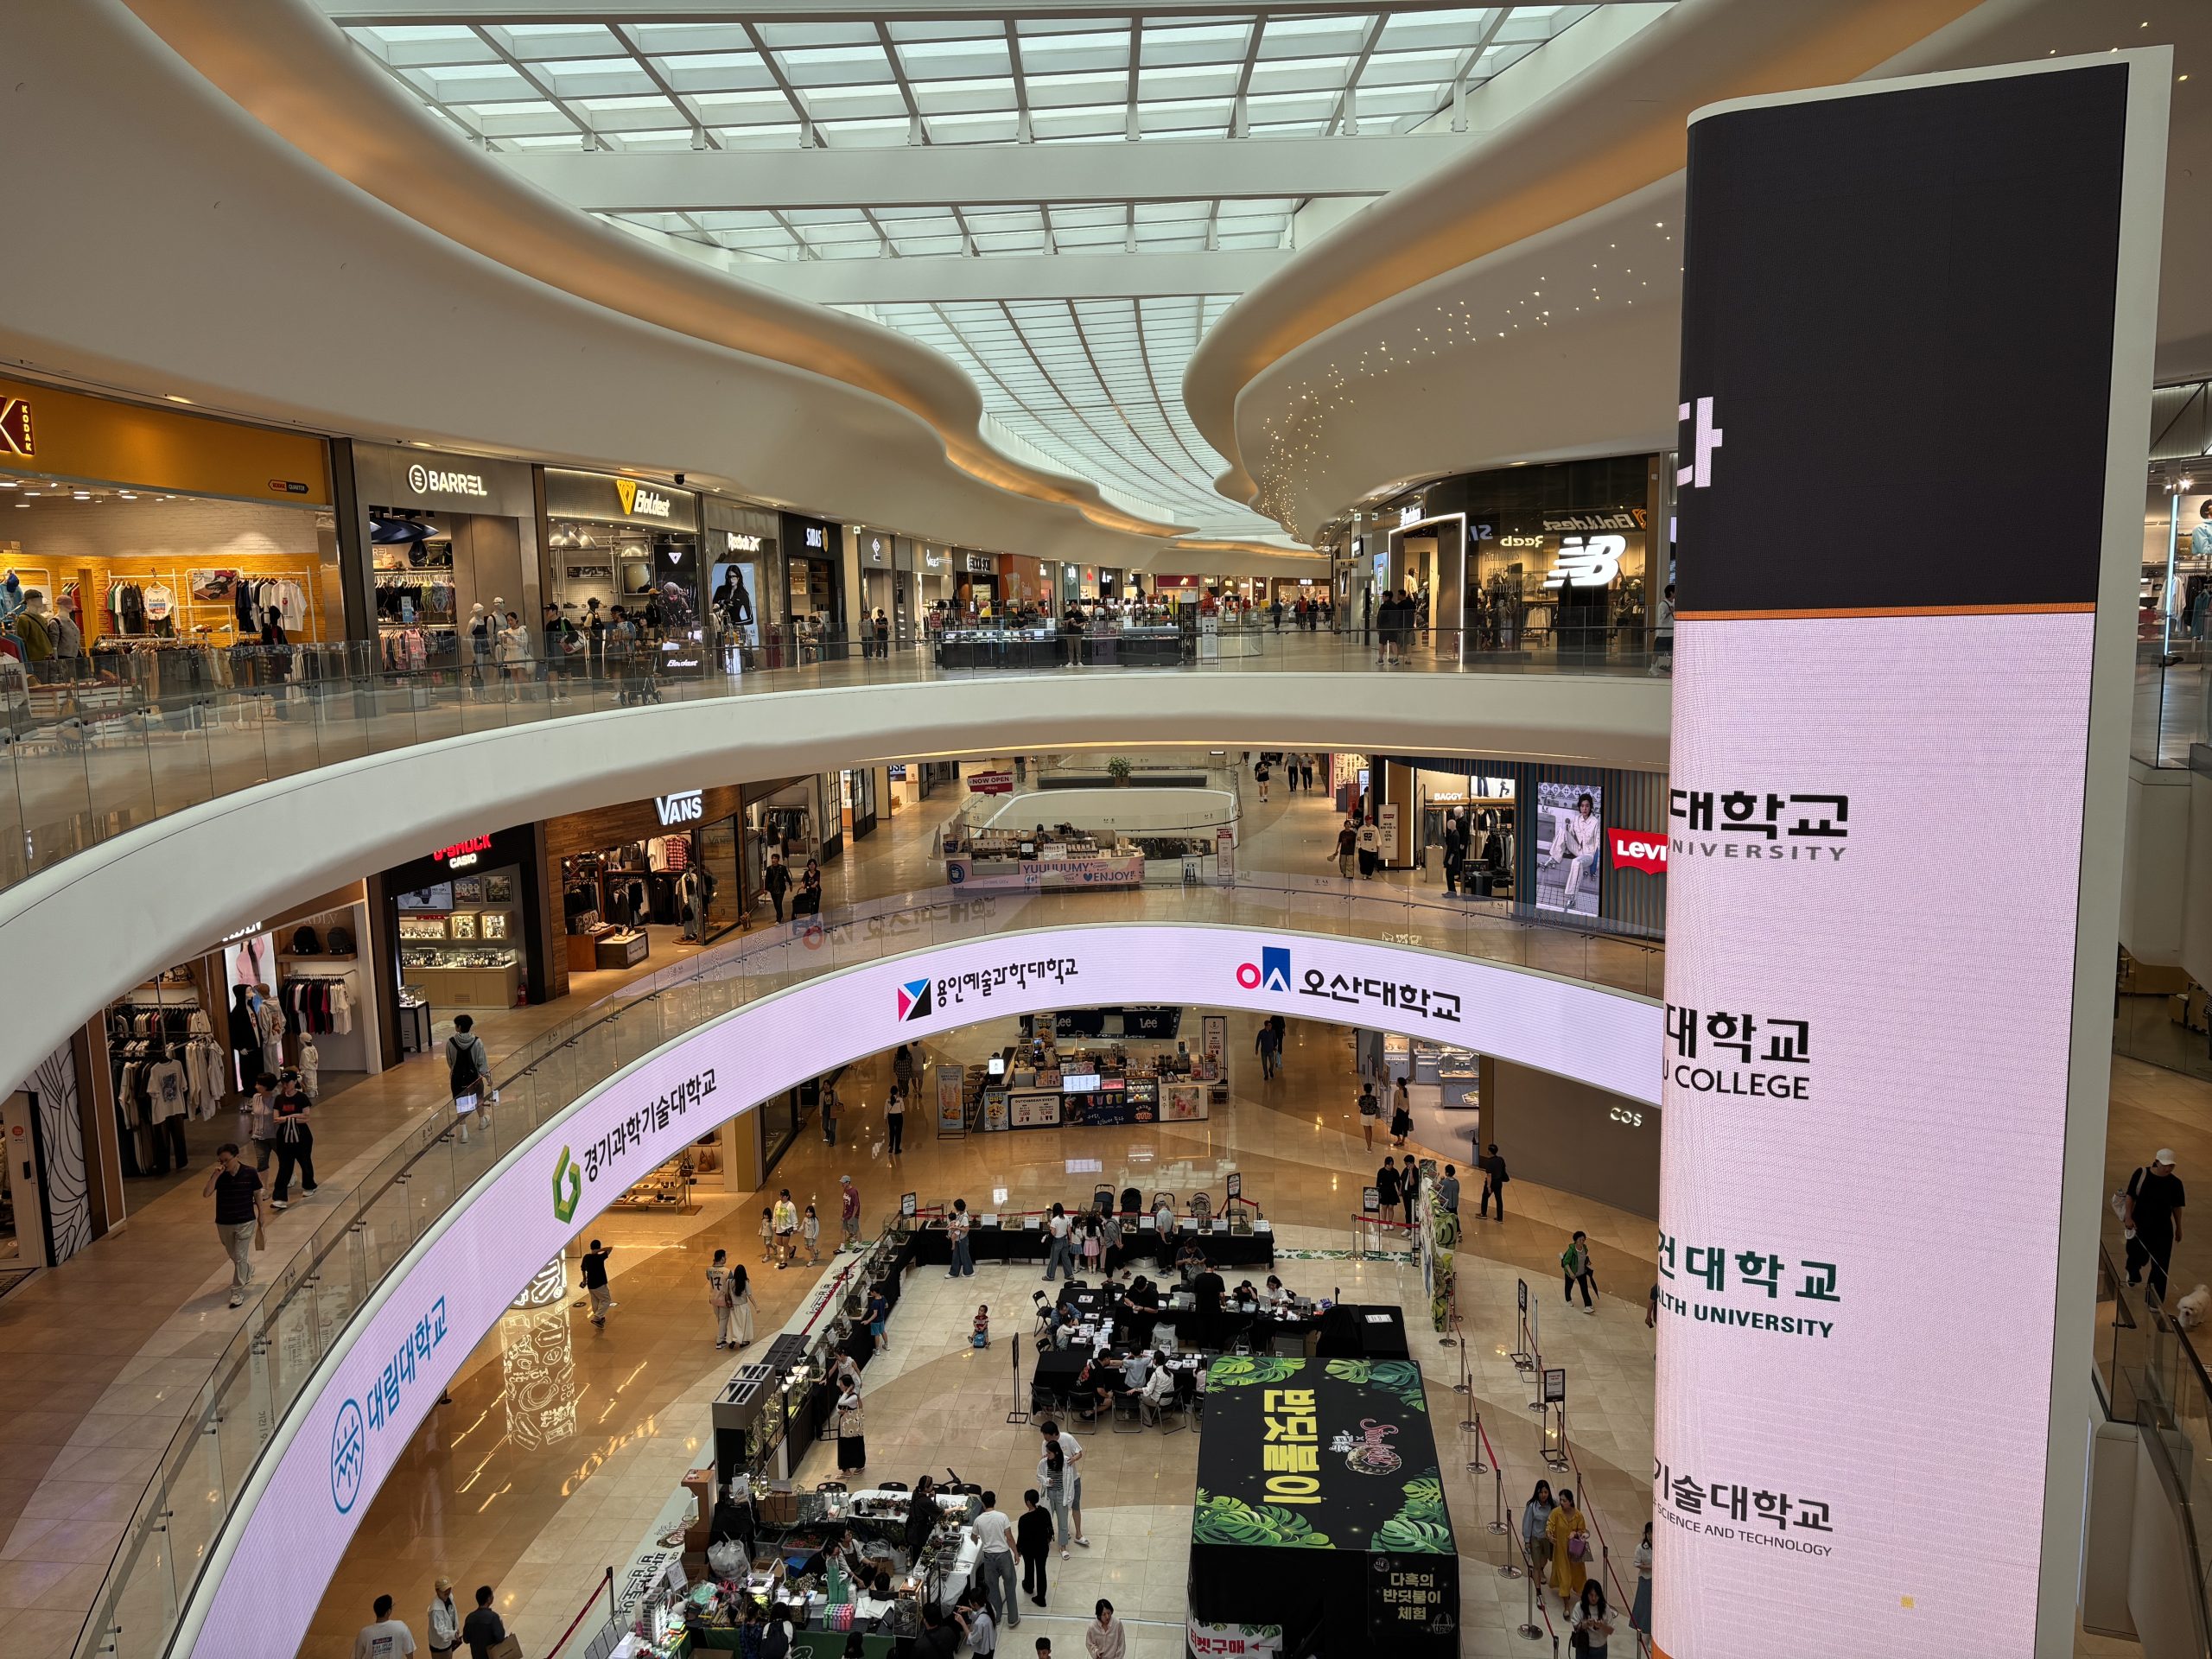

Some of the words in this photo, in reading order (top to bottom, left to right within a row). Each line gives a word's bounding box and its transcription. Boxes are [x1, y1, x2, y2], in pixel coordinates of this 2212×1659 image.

[22, 404, 32, 451] KODAK
[429, 470, 487, 496] BARREL
[634, 490, 671, 518] Boldest
[806, 527, 822, 548] SIDAS
[654, 789, 702, 826] VANS
[1434, 792, 1463, 801] BAGGY
[449, 854, 477, 868] CASIO
[937, 957, 1078, 1007] 용인예술과학대학교
[1299, 969, 1461, 1022] 오산대학교
[1140, 1018, 1158, 1029] Lee
[1675, 1065, 1810, 1100] COLLEGE
[584, 1067, 717, 1183] 경기과학기술대학교
[1609, 1107, 1643, 1128] COS
[1694, 1304, 1834, 1338] UNIVERSITY
[366, 1294, 448, 1432] 대림대학교
[1262, 1389, 1322, 1504] 반딧불이
[1657, 1502, 1700, 1533] SCIENCE
[1705, 1524, 1735, 1539] AND
[1738, 1529, 1833, 1557] TECHNOLOGY
[1390, 1573, 1434, 1588] 다흑의
[1382, 1588, 1441, 1605] 반딧불이
[1397, 1606, 1427, 1621] 체험
[1190, 1628, 1245, 1656] 티켓구매
